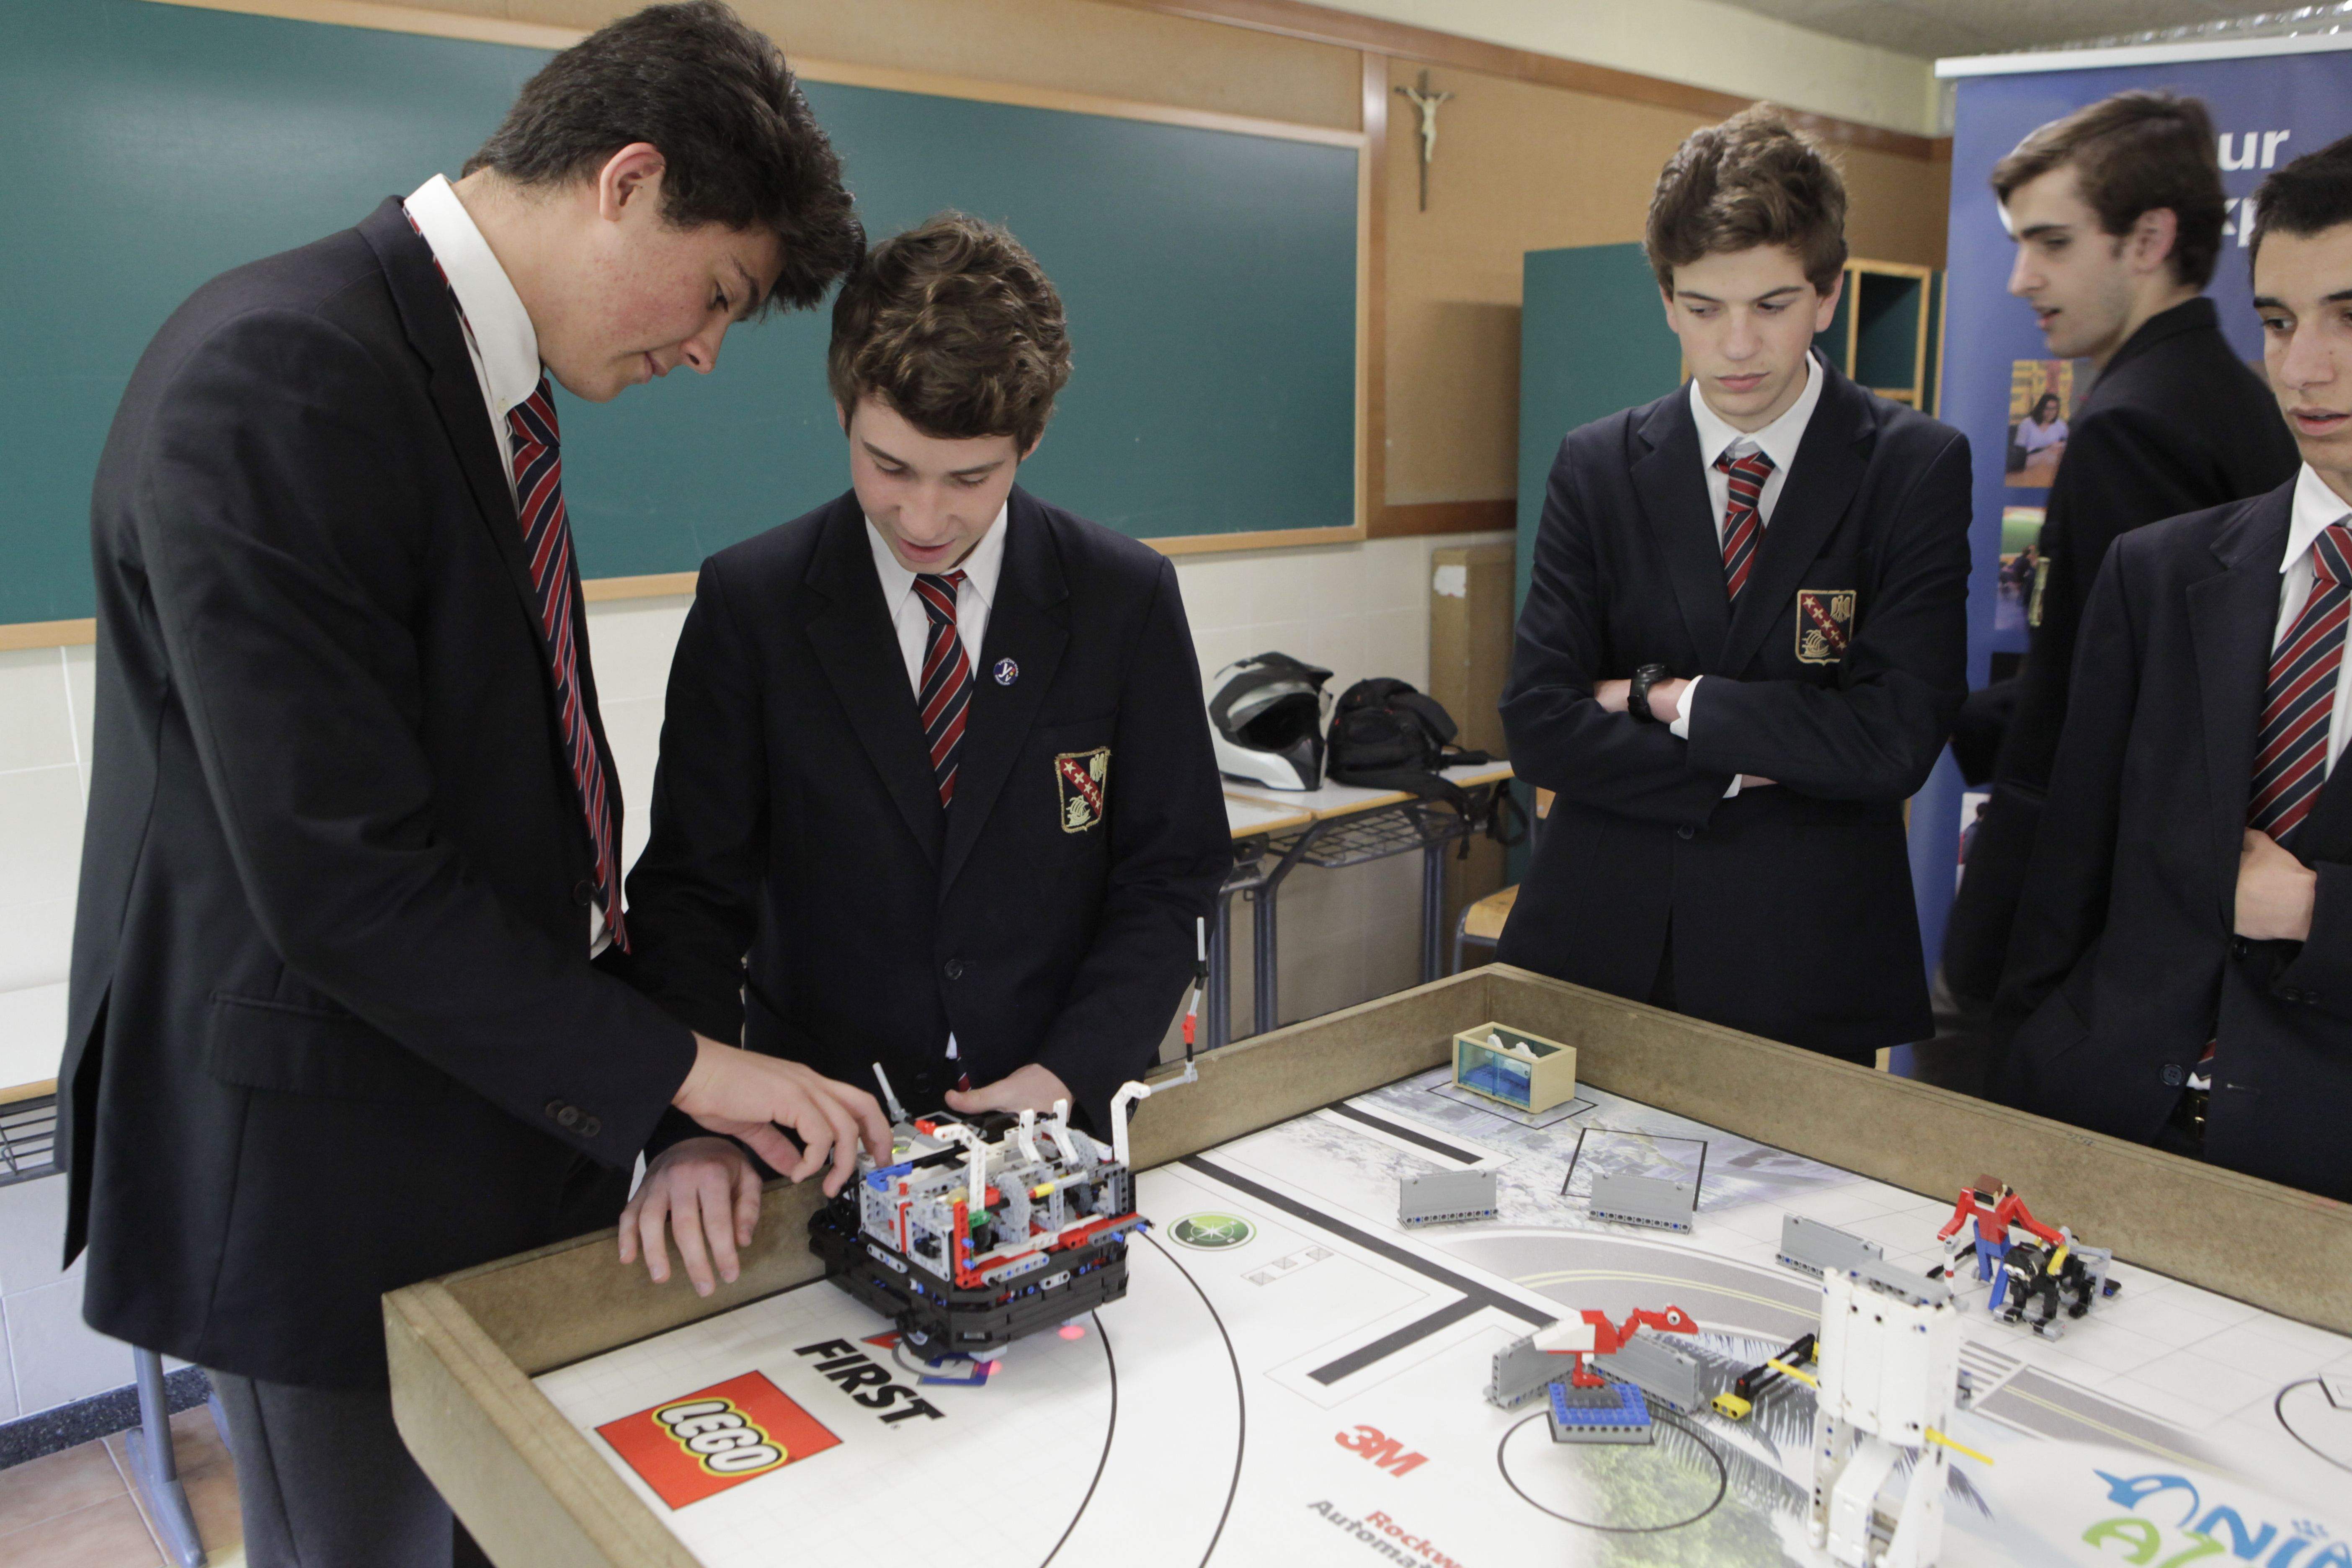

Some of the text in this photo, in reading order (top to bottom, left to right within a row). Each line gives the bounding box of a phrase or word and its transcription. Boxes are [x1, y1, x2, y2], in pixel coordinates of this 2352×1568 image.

[792, 1338, 946, 1424] FIRST
[657, 1400, 782, 1473] LEGO
[1335, 1424, 1430, 1478] 3M
